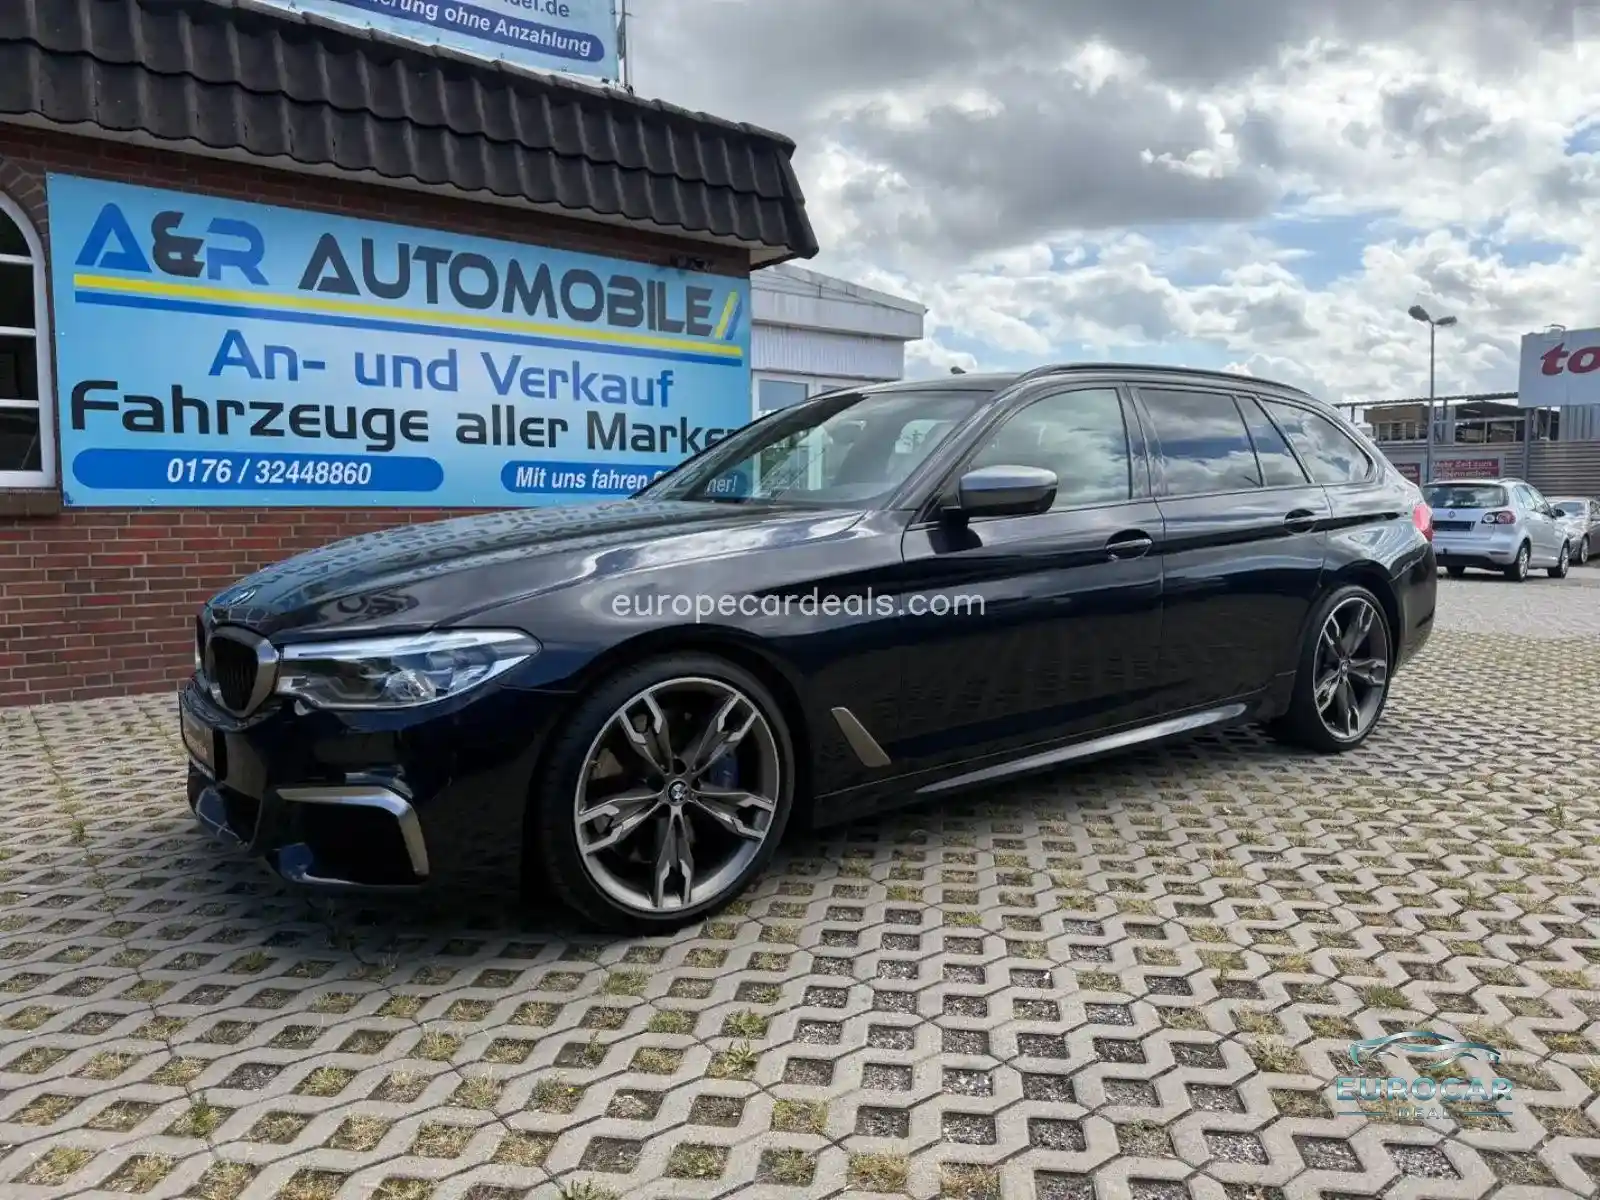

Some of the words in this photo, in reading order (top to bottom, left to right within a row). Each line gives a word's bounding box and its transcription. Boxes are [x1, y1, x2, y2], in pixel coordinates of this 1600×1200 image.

[444, 6, 490, 31] ohne
[494, 19, 591, 57] Anzahlung
[74, 202, 269, 286] A&R
[298, 232, 713, 336] AUTOMOBILE
[208, 329, 326, 381] An-
[355, 348, 457, 392] und
[480, 352, 674, 408] Verkauf
[71, 380, 429, 452] Fahrzeuge
[456, 404, 568, 449] aller
[166, 458, 233, 483] 0176
[254, 460, 373, 485] 32448860
[515, 466, 546, 489] Mit
[551, 471, 586, 489] uns
[591, 468, 648, 490] fahren
